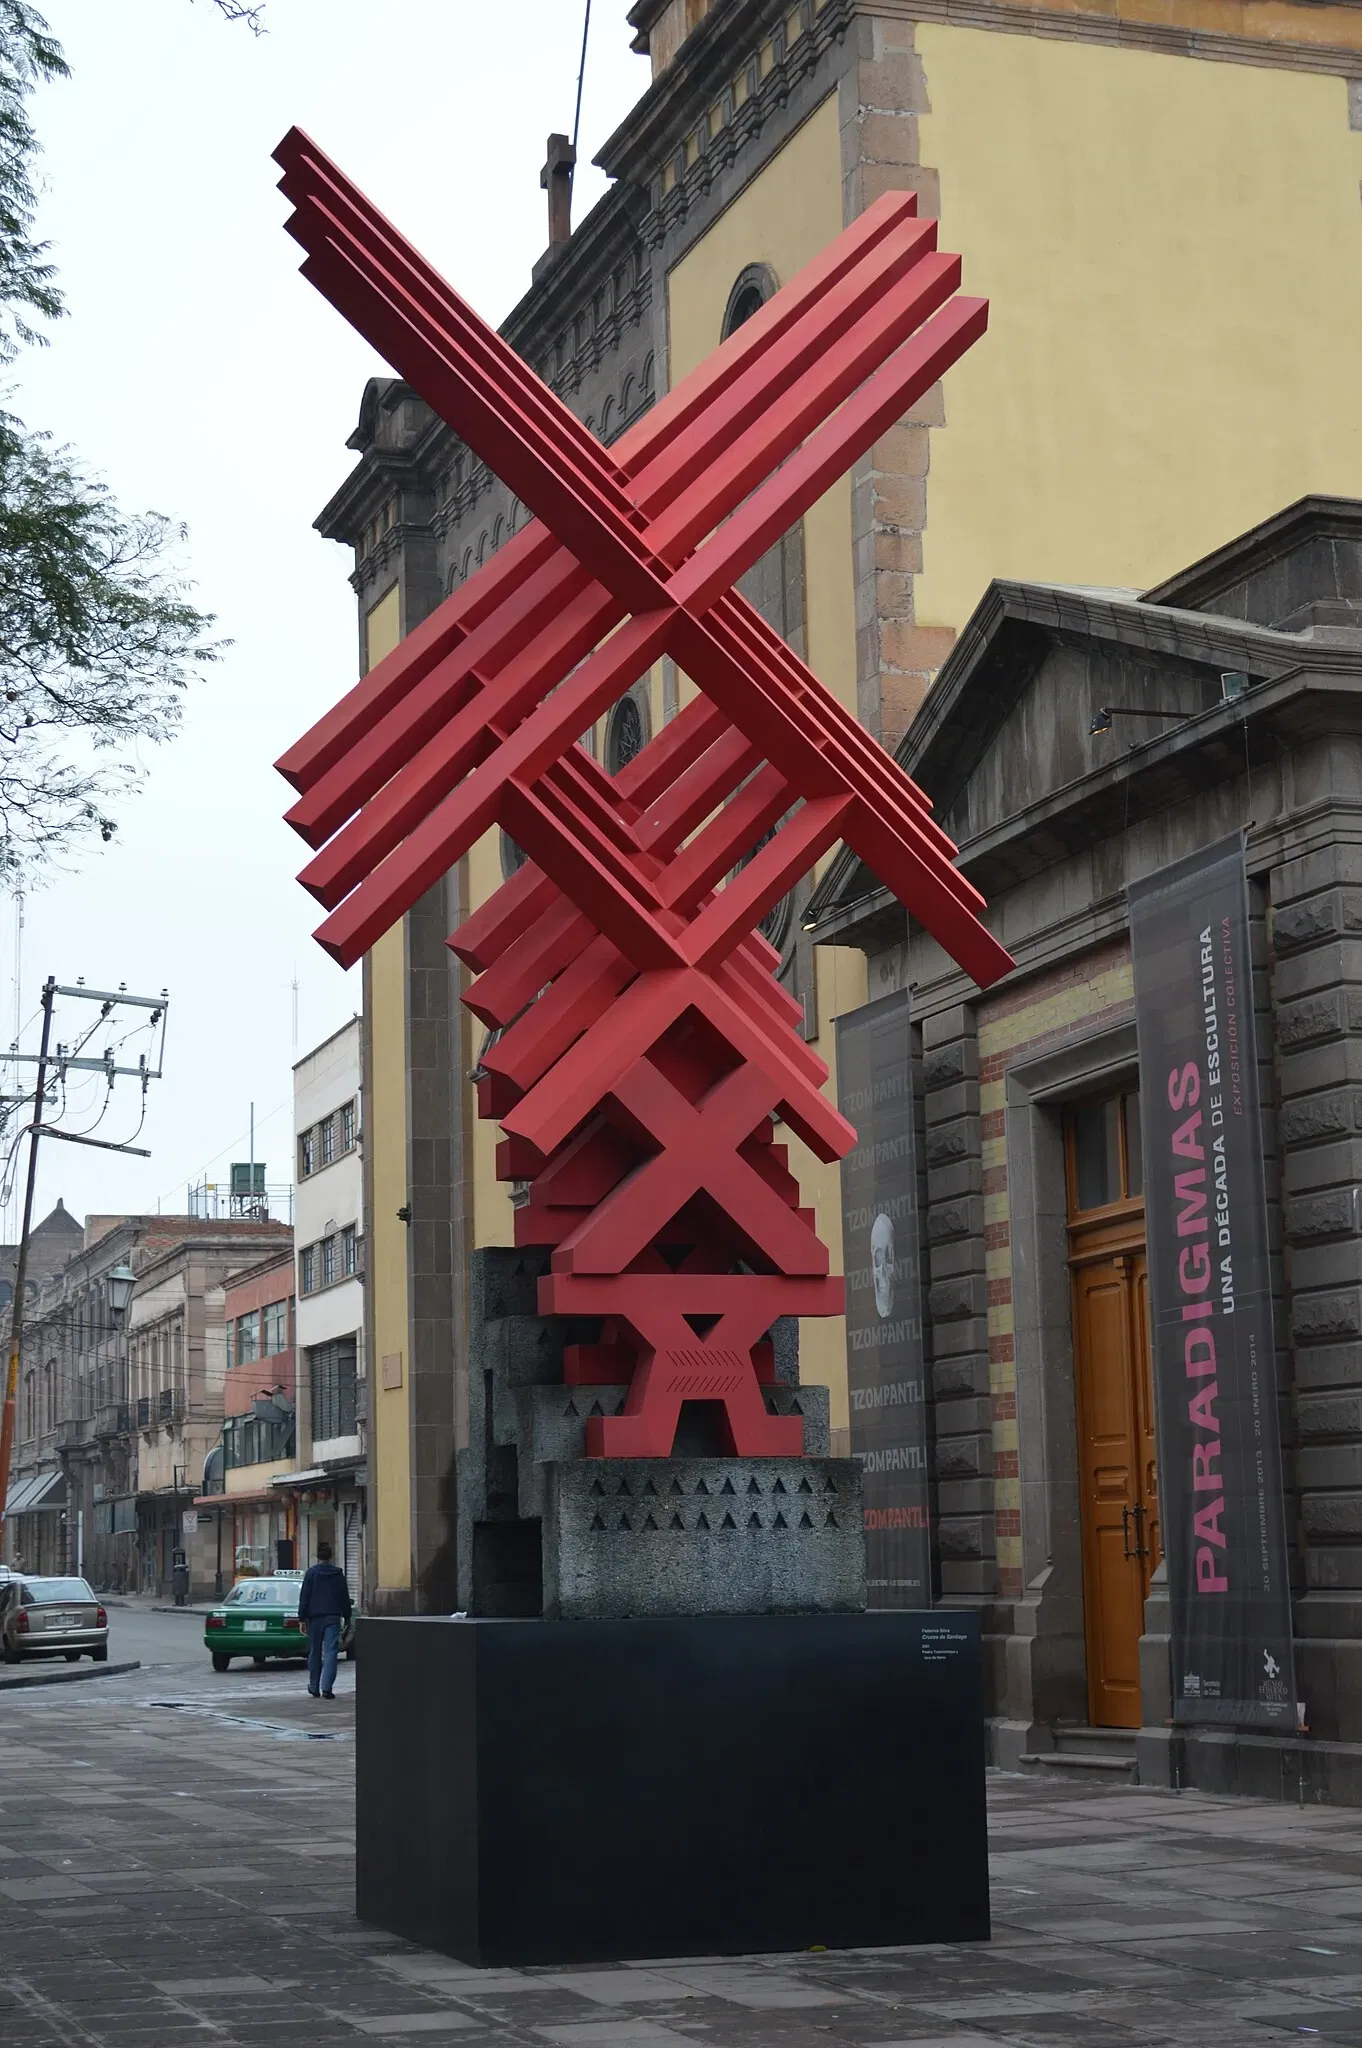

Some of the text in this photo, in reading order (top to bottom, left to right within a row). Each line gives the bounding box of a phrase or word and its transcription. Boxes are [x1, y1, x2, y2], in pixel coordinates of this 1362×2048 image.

[1222, 916, 1242, 1116] EXPOSICIÓN COLECTIVA
[1200, 925, 1235, 1314] UNA DÉCADA DE ESCULTURA
[849, 1317, 922, 1350] TZOMPANTLI
[1168, 1061, 1229, 1593] PARADIGMAS
[850, 1380, 924, 1411] TZOMPANTLI
[1251, 1372, 1260, 1415] ENERO
[1258, 1489, 1269, 1570] SEPTIEMBRE
